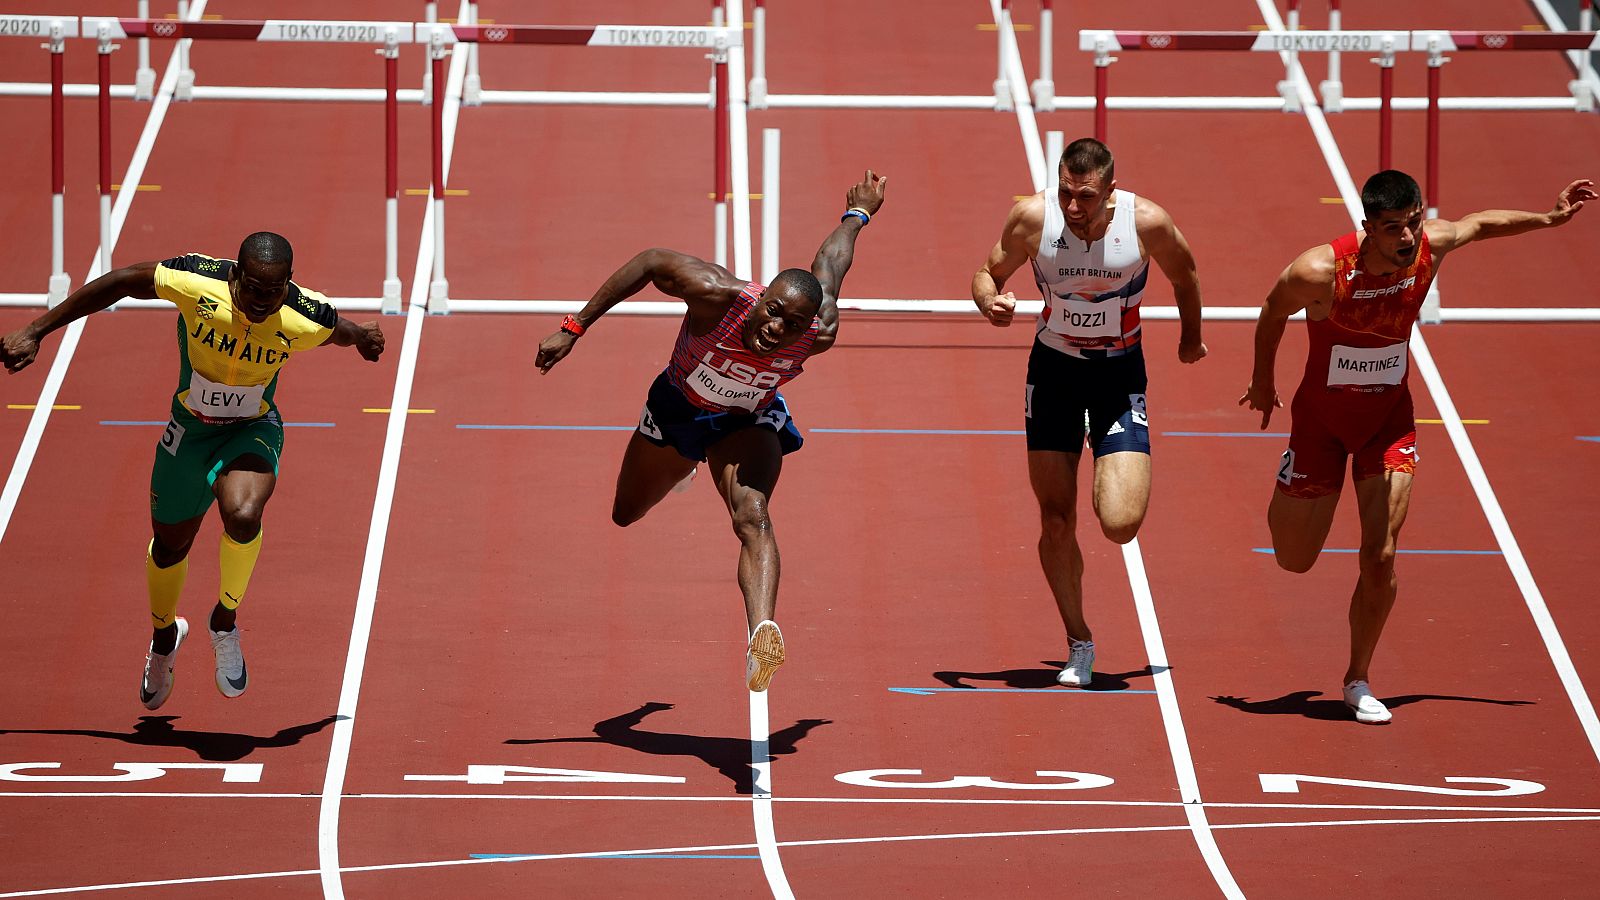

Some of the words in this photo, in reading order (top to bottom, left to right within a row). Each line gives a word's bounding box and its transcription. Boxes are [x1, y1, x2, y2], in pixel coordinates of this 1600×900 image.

[0, 19, 40, 34] 2020
[278, 24, 332, 40] TOKYO
[337, 26, 376, 41] 2020
[608, 29, 662, 44] TOKYO
[667, 30, 707, 45] 2020
[1272, 35, 1328, 50] TOKYO
[1331, 35, 1372, 50] 2020
[1058, 267, 1085, 277] GREAT
[1087, 268, 1122, 279] BRITAIN
[1352, 276, 1416, 299] ESPAÑA
[1063, 308, 1106, 328] POZZI
[191, 322, 289, 365] JAMAICA
[700, 351, 782, 388] USA
[1337, 355, 1400, 373] MARTINEZ
[697, 369, 760, 400] HOLLOWAY
[201, 389, 246, 407] LEVY
[162, 422, 177, 447] 5
[644, 414, 656, 435] 4
[1278, 451, 1291, 480] 2
[0, 761, 264, 783] 5
[404, 764, 686, 785] 4
[833, 769, 1115, 791] 3
[1258, 773, 1546, 797] 2
